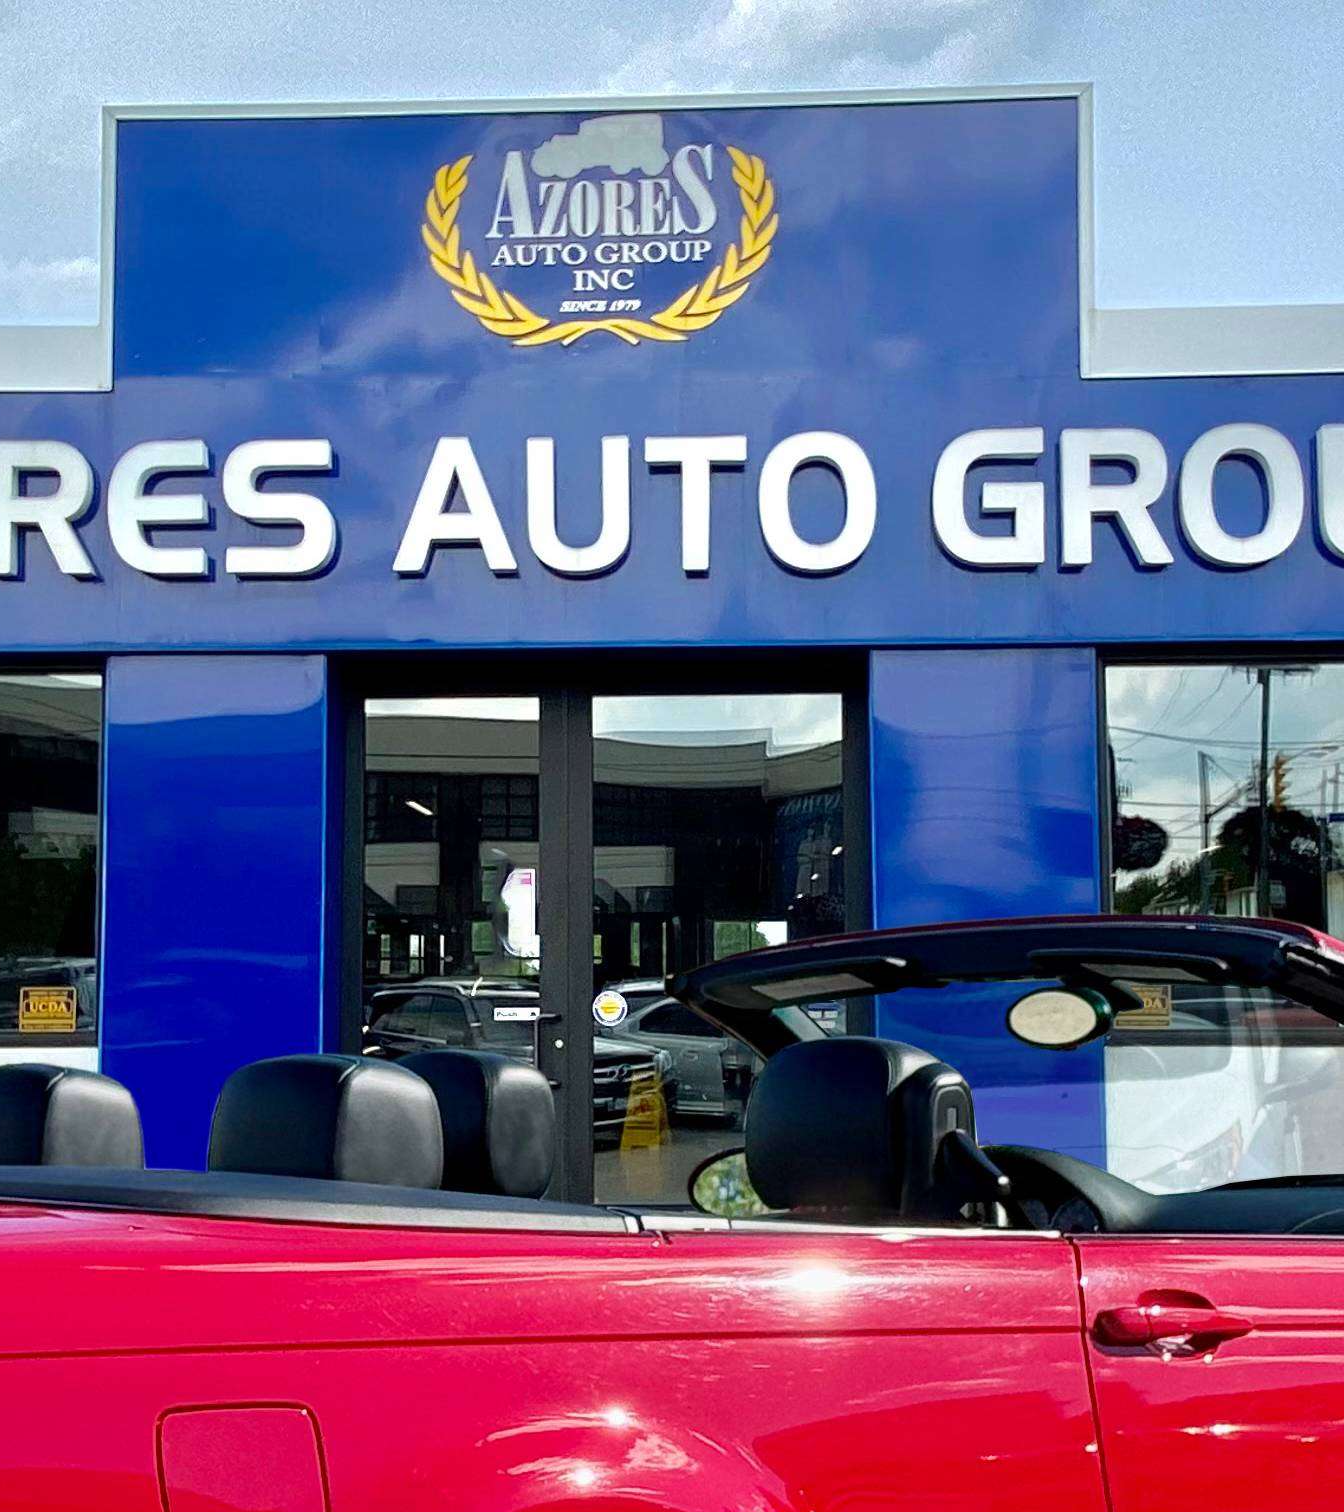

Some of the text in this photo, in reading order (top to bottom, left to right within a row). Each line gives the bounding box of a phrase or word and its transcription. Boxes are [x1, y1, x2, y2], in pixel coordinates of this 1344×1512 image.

[485, 143, 719, 240] AZORES
[491, 240, 713, 267] AUTO GROUP
[572, 269, 635, 292] INC
[392, 430, 878, 577] AUTO
[28, 1001, 70, 1014] UCDA
